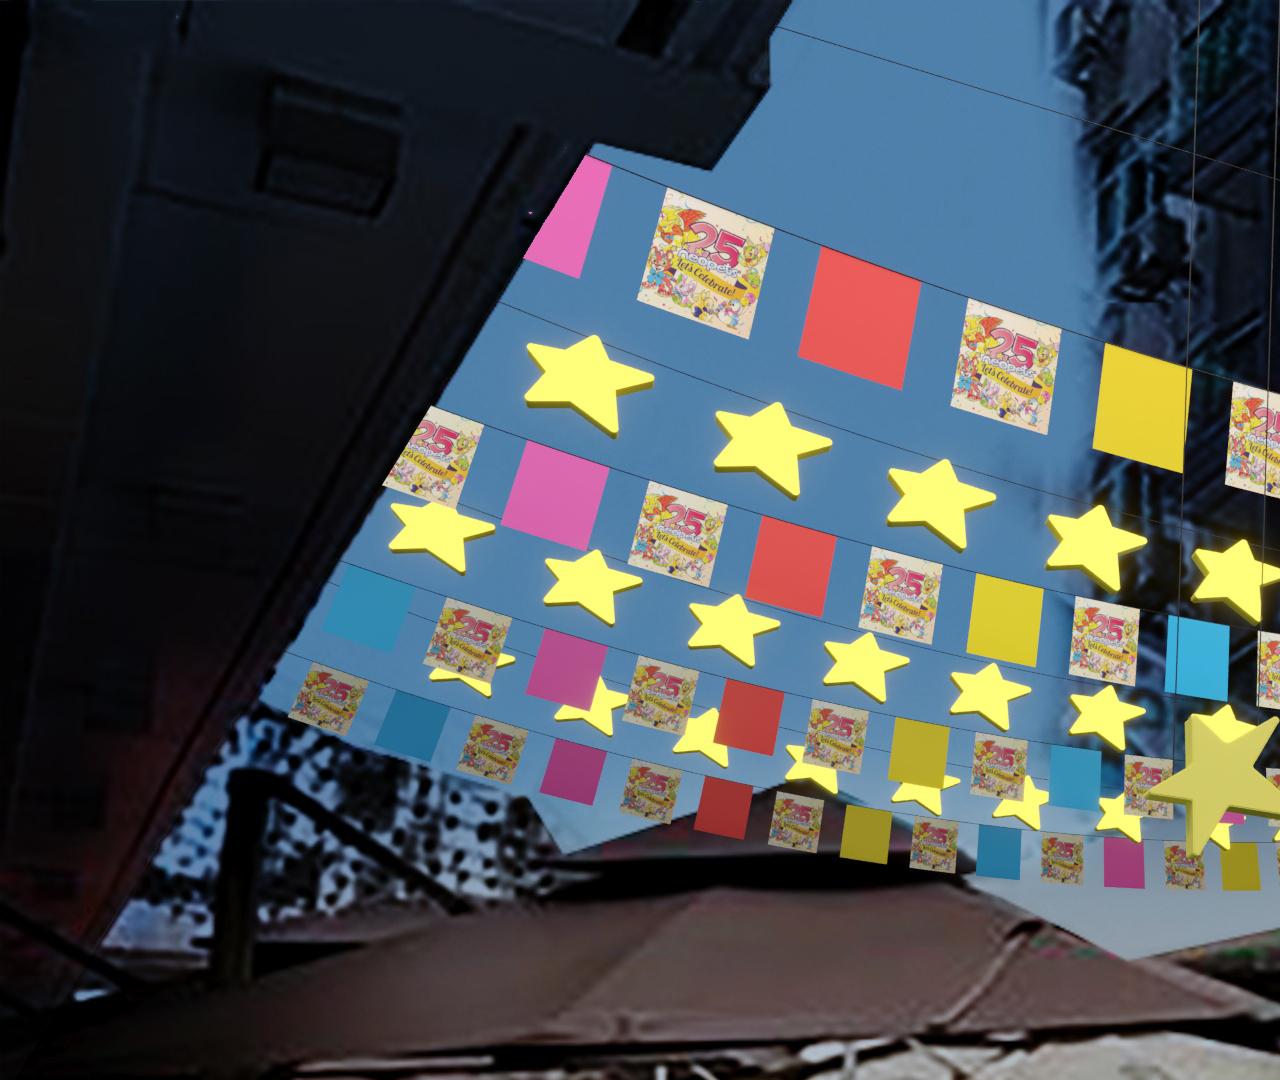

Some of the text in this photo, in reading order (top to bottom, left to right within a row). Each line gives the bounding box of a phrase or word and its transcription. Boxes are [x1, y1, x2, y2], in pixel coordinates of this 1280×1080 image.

[682, 220, 746, 268] 25
[676, 248, 738, 277] neopets
[676, 257, 736, 296] Let's Celebrate!
[985, 326, 1038, 370] 25
[980, 354, 1034, 377] neopets
[981, 362, 1033, 396] Let's Celebrate!
[410, 420, 459, 456] 25
[412, 455, 448, 478] Celebrate!
[660, 502, 707, 536] 25
[884, 565, 925, 597] 25
[453, 615, 494, 643] 25
[1089, 613, 1124, 642] 25
[316, 677, 353, 701] 25
[647, 671, 683, 697] 25
[822, 713, 855, 737] 25
[480, 729, 514, 751] 25
[986, 744, 1015, 767] 25
